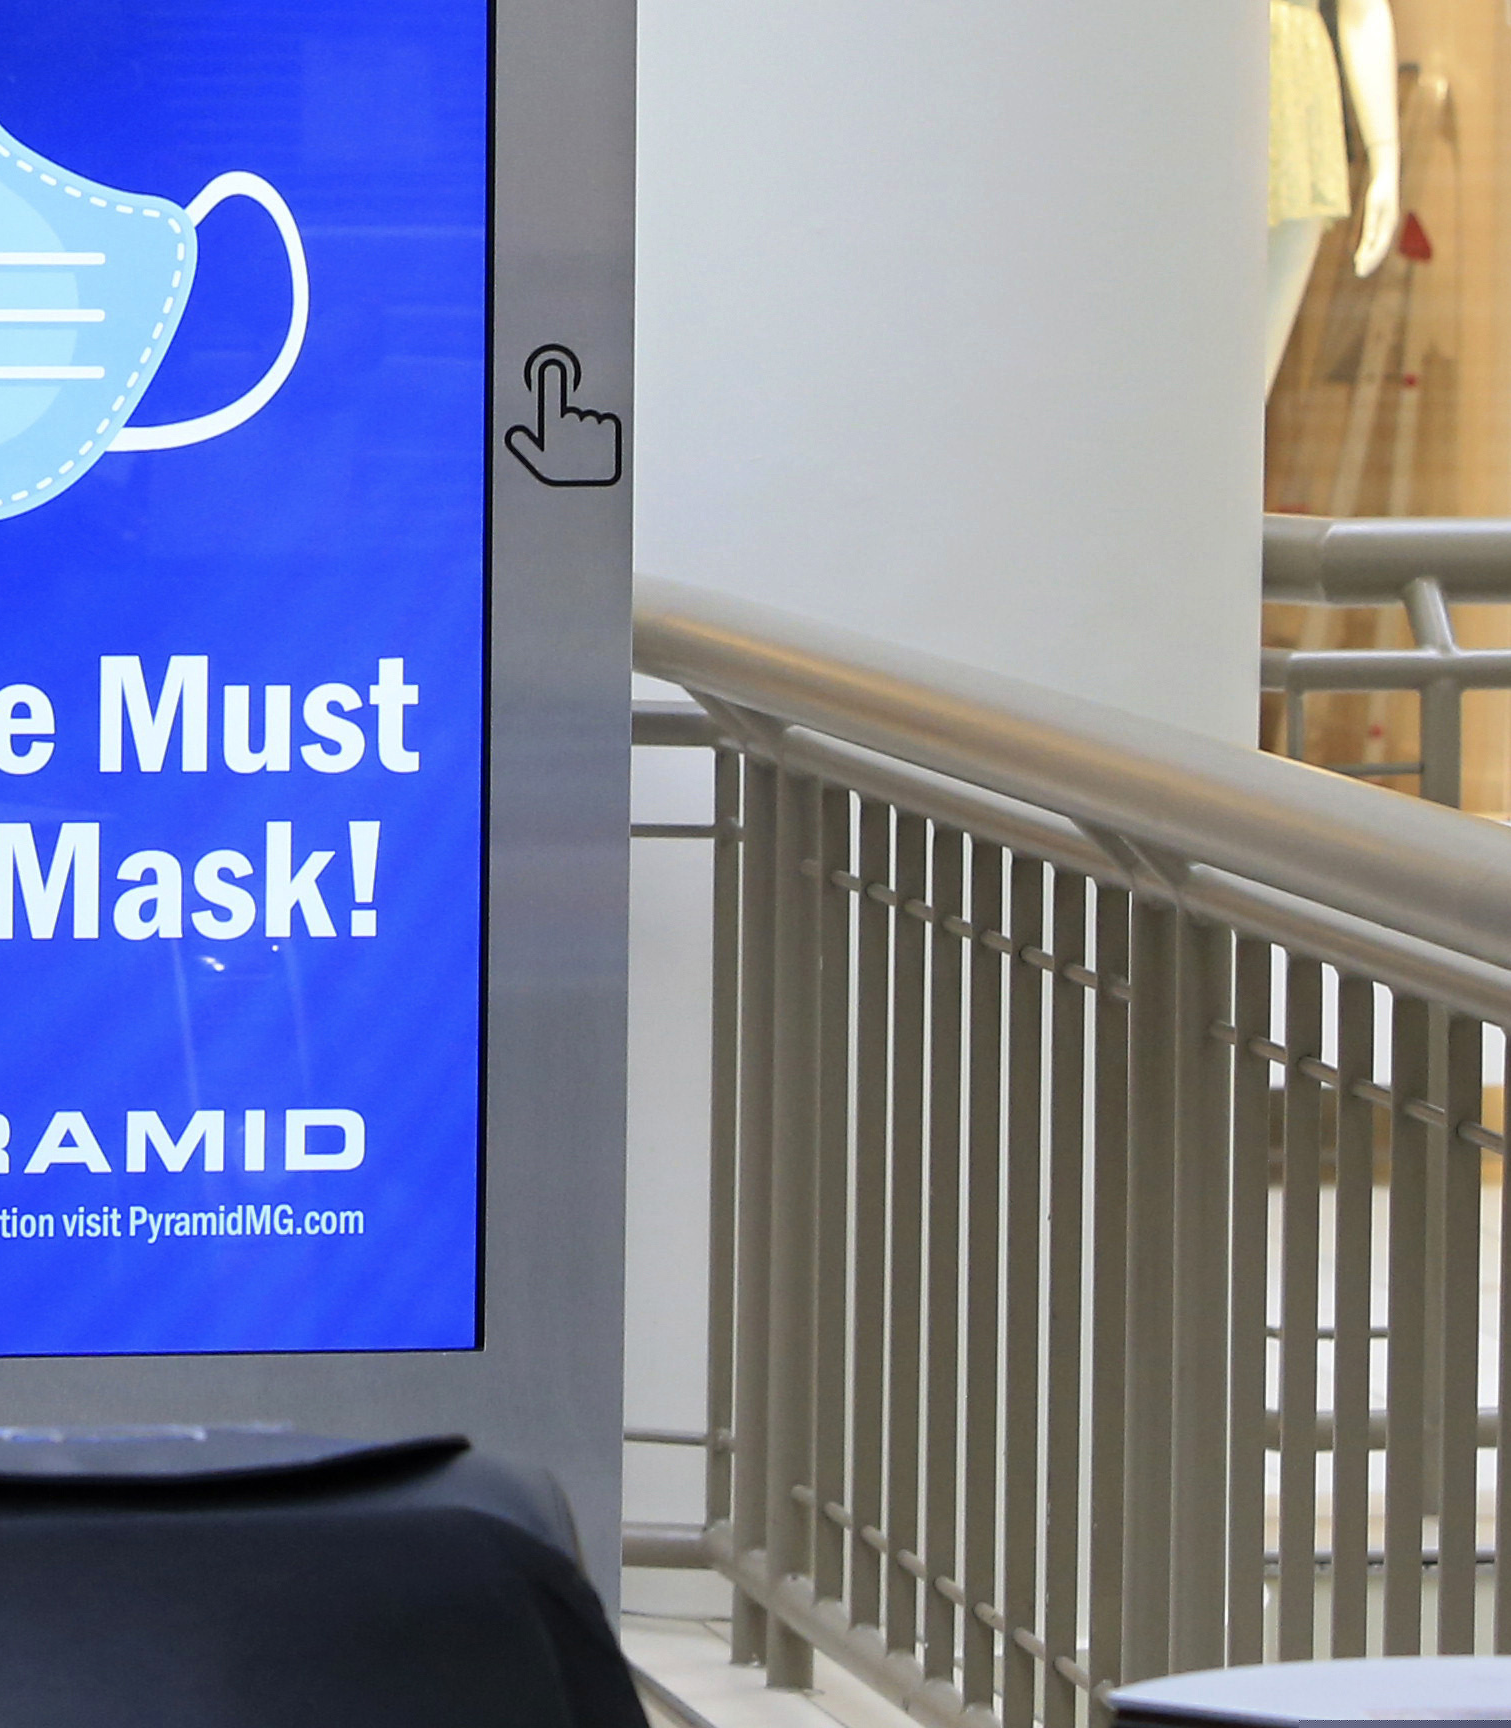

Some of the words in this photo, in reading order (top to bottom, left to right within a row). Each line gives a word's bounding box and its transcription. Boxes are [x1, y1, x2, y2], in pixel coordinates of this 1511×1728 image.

[100, 656, 419, 773] Must
[63, 1207, 121, 1237] visit
[130, 1205, 363, 1243] PyramidMG.com
